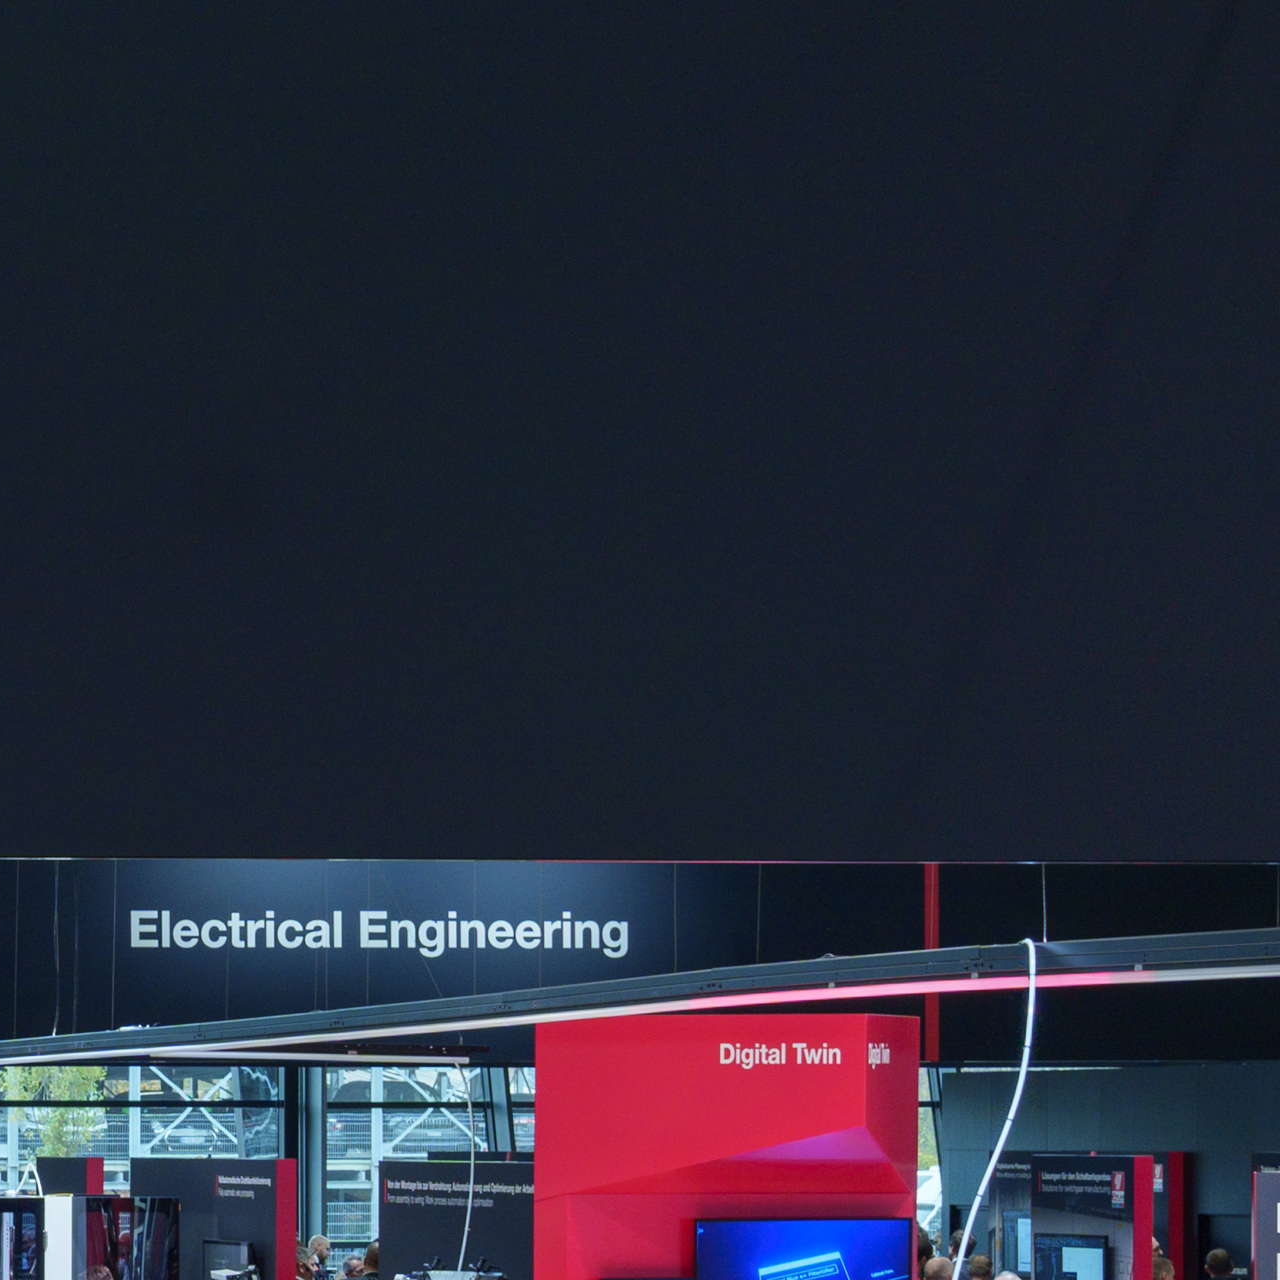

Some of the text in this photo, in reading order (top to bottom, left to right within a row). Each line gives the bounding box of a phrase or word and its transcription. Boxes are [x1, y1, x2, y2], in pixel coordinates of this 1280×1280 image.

[130, 910, 629, 959] Electrical Engineering
[719, 1043, 841, 1070] Digital Twin
